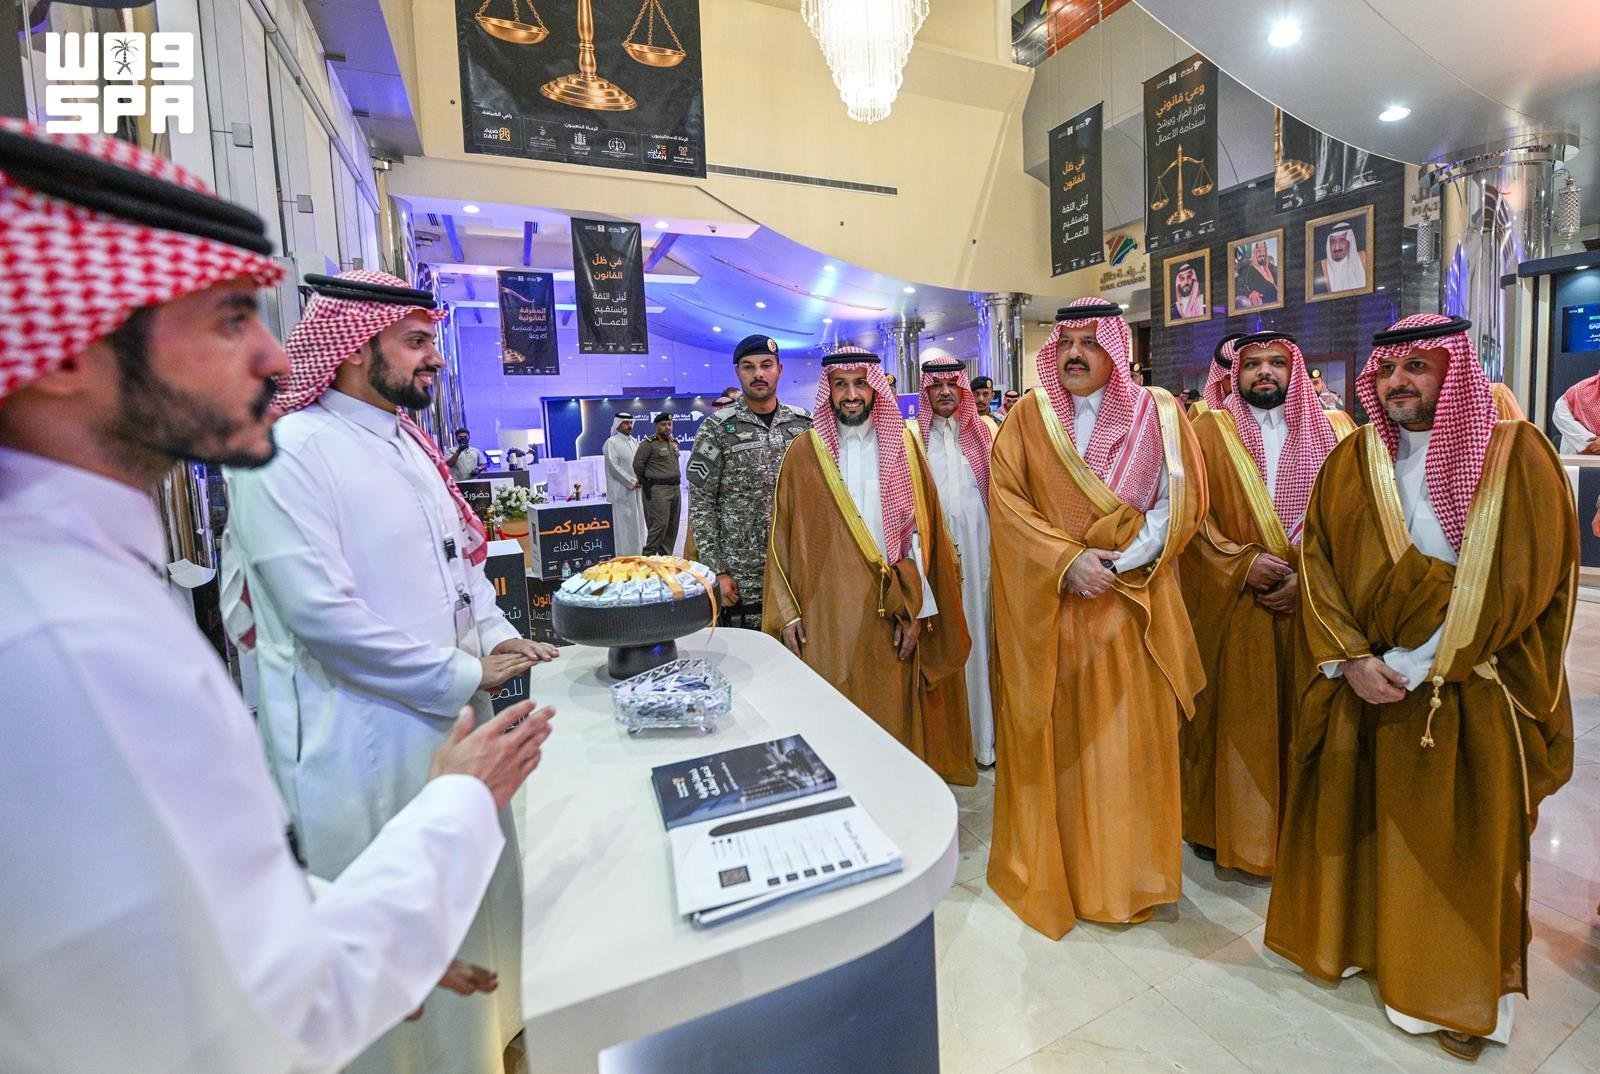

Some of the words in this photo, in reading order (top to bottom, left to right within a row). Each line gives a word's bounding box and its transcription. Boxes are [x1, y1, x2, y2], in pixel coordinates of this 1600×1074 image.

[1155, 92, 1184, 118] قانوني
[1179, 115, 1206, 134] استدامة
[1063, 173, 1086, 192] القانون
[609, 257, 622, 270] في
[593, 270, 623, 281] القانون
[592, 291, 610, 300] الثقة
[594, 306, 628, 316] وتستقيم
[594, 316, 628, 326] الأعمال
[463, 490, 490, 501] حضورك
[538, 517, 610, 536] حضوركم
[553, 540, 579, 553] اللقاء
[581, 540, 603, 553] يثري
